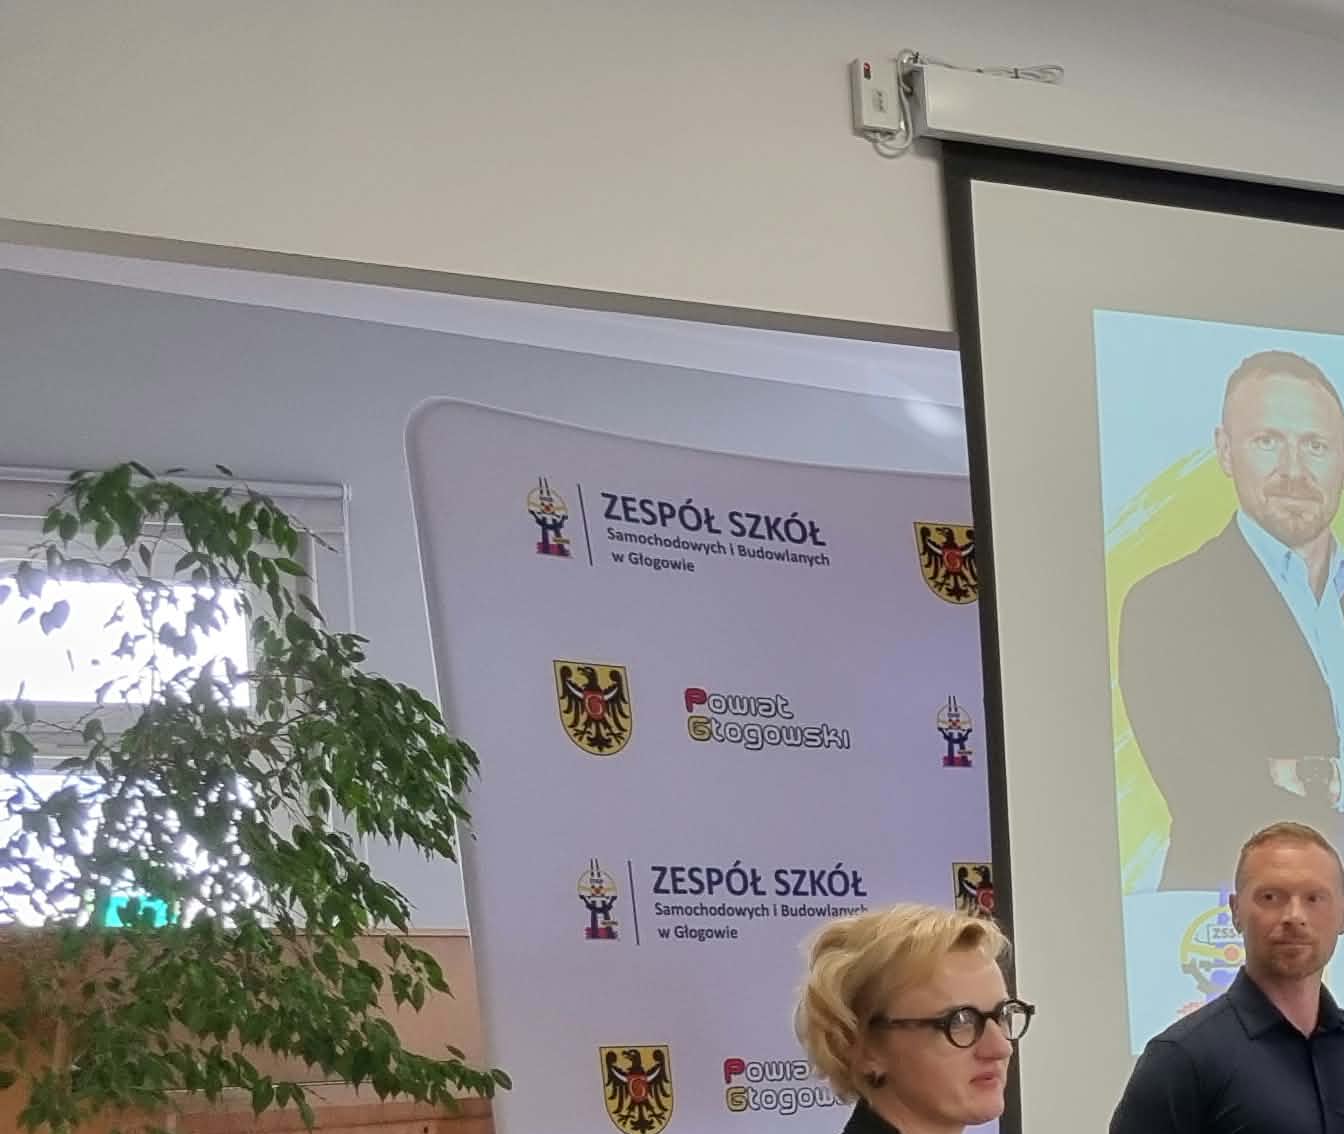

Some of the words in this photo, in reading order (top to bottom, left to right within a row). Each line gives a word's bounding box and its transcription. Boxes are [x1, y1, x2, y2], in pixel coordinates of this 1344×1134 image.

[601, 492, 722, 535] ZESPÓŁ
[728, 511, 827, 547] SZKÓŁ
[607, 527, 727, 556] Samochodowych
[730, 543, 735, 556] i
[737, 544, 830, 567] Budowlanych
[611, 551, 624, 563] w
[628, 551, 695, 573] Głogowie
[684, 687, 794, 720] Powiat
[687, 715, 850, 751] Głogowski
[651, 860, 767, 897] ZESPÓŁ
[774, 862, 868, 897] SZKÓŁ
[655, 901, 770, 921] Samochodowych
[773, 903, 777, 917] i
[658, 928, 669, 939] w
[673, 925, 738, 942] Głogowie
[724, 1058, 810, 1084] Powia
[726, 1086, 845, 1115] Głogow
